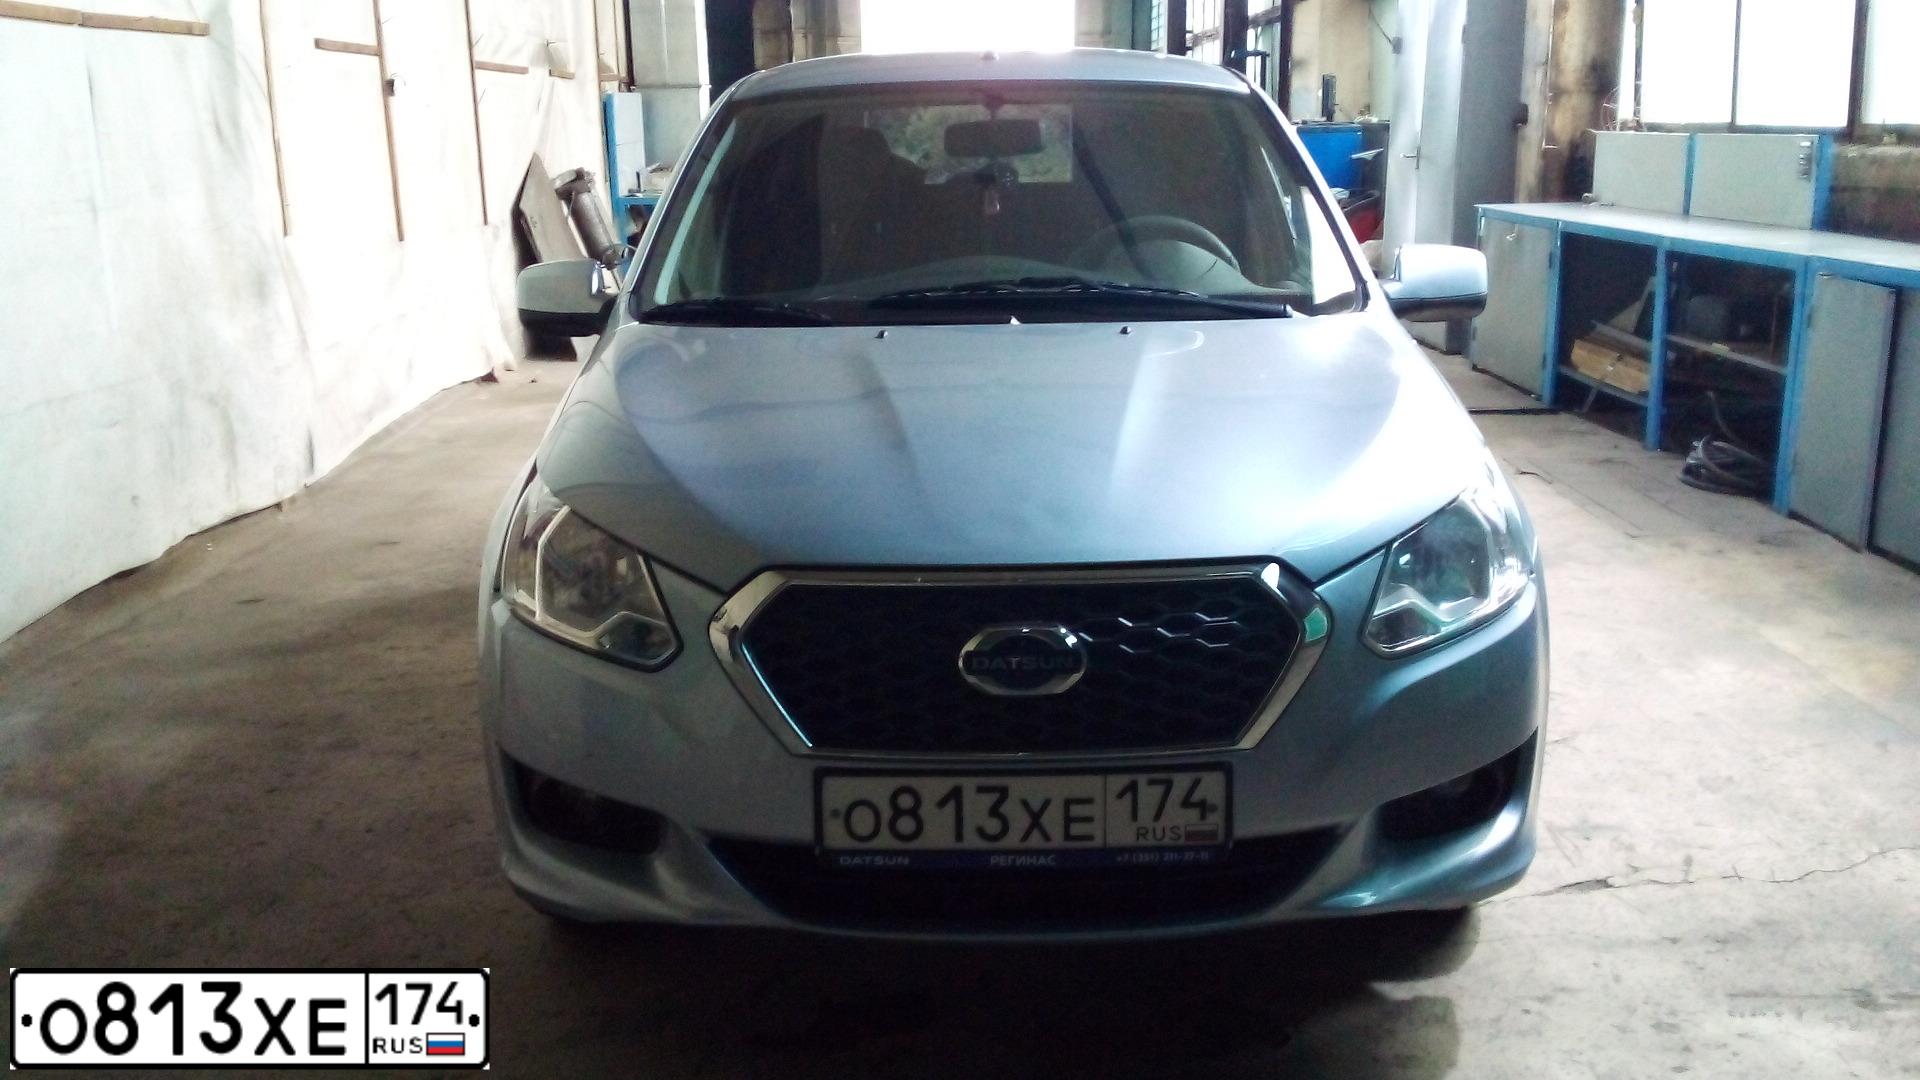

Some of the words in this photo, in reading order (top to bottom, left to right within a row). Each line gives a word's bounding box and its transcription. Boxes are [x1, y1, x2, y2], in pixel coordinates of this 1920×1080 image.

[971, 655, 1073, 670] DATSUN
[1115, 777, 1208, 823] 174
[1136, 826, 1182, 842] RUS
[839, 855, 910, 866] DATSUN
[990, 854, 1056, 866] РЕГИНАС
